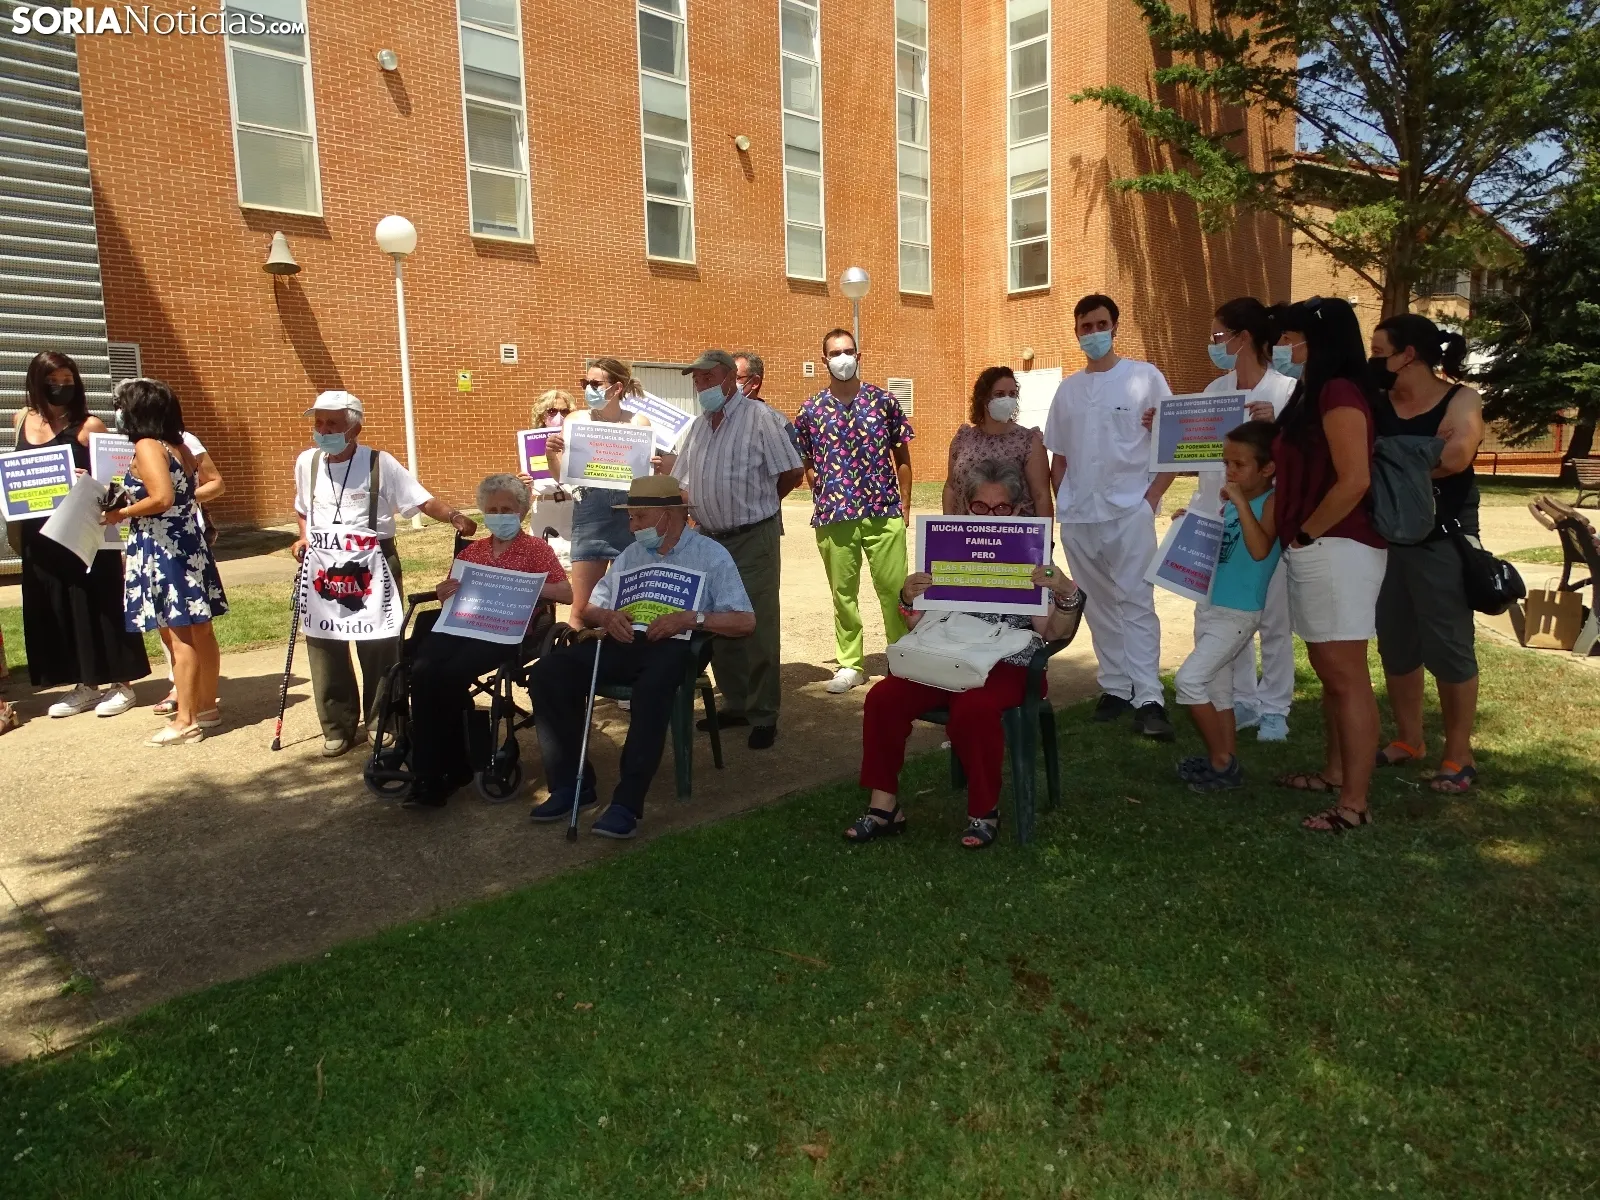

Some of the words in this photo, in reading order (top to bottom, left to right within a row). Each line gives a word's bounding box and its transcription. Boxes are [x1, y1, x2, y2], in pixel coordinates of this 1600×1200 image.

[21, 453, 64, 465] ENFERMERA
[6, 470, 25, 479] PARA
[26, 465, 59, 476] ATENDER
[23, 475, 66, 487] RESIDENTES
[10, 488, 58, 499] NECESITAMOS
[966, 525, 1024, 534] CONSEJERÍA
[1188, 549, 1207, 558] JUNTA
[960, 565, 1018, 574] ENFERMERAS
[625, 575, 637, 584] UNA
[639, 570, 692, 583] ENFERMERA
[483, 582, 512, 590] NUESTROS
[622, 584, 637, 595] PARA
[639, 581, 680, 592] ATENDER
[620, 597, 631, 606] 170
[631, 592, 685, 606] RESIDENTES
[304, 614, 312, 628] el
[320, 618, 374, 634] olvido
